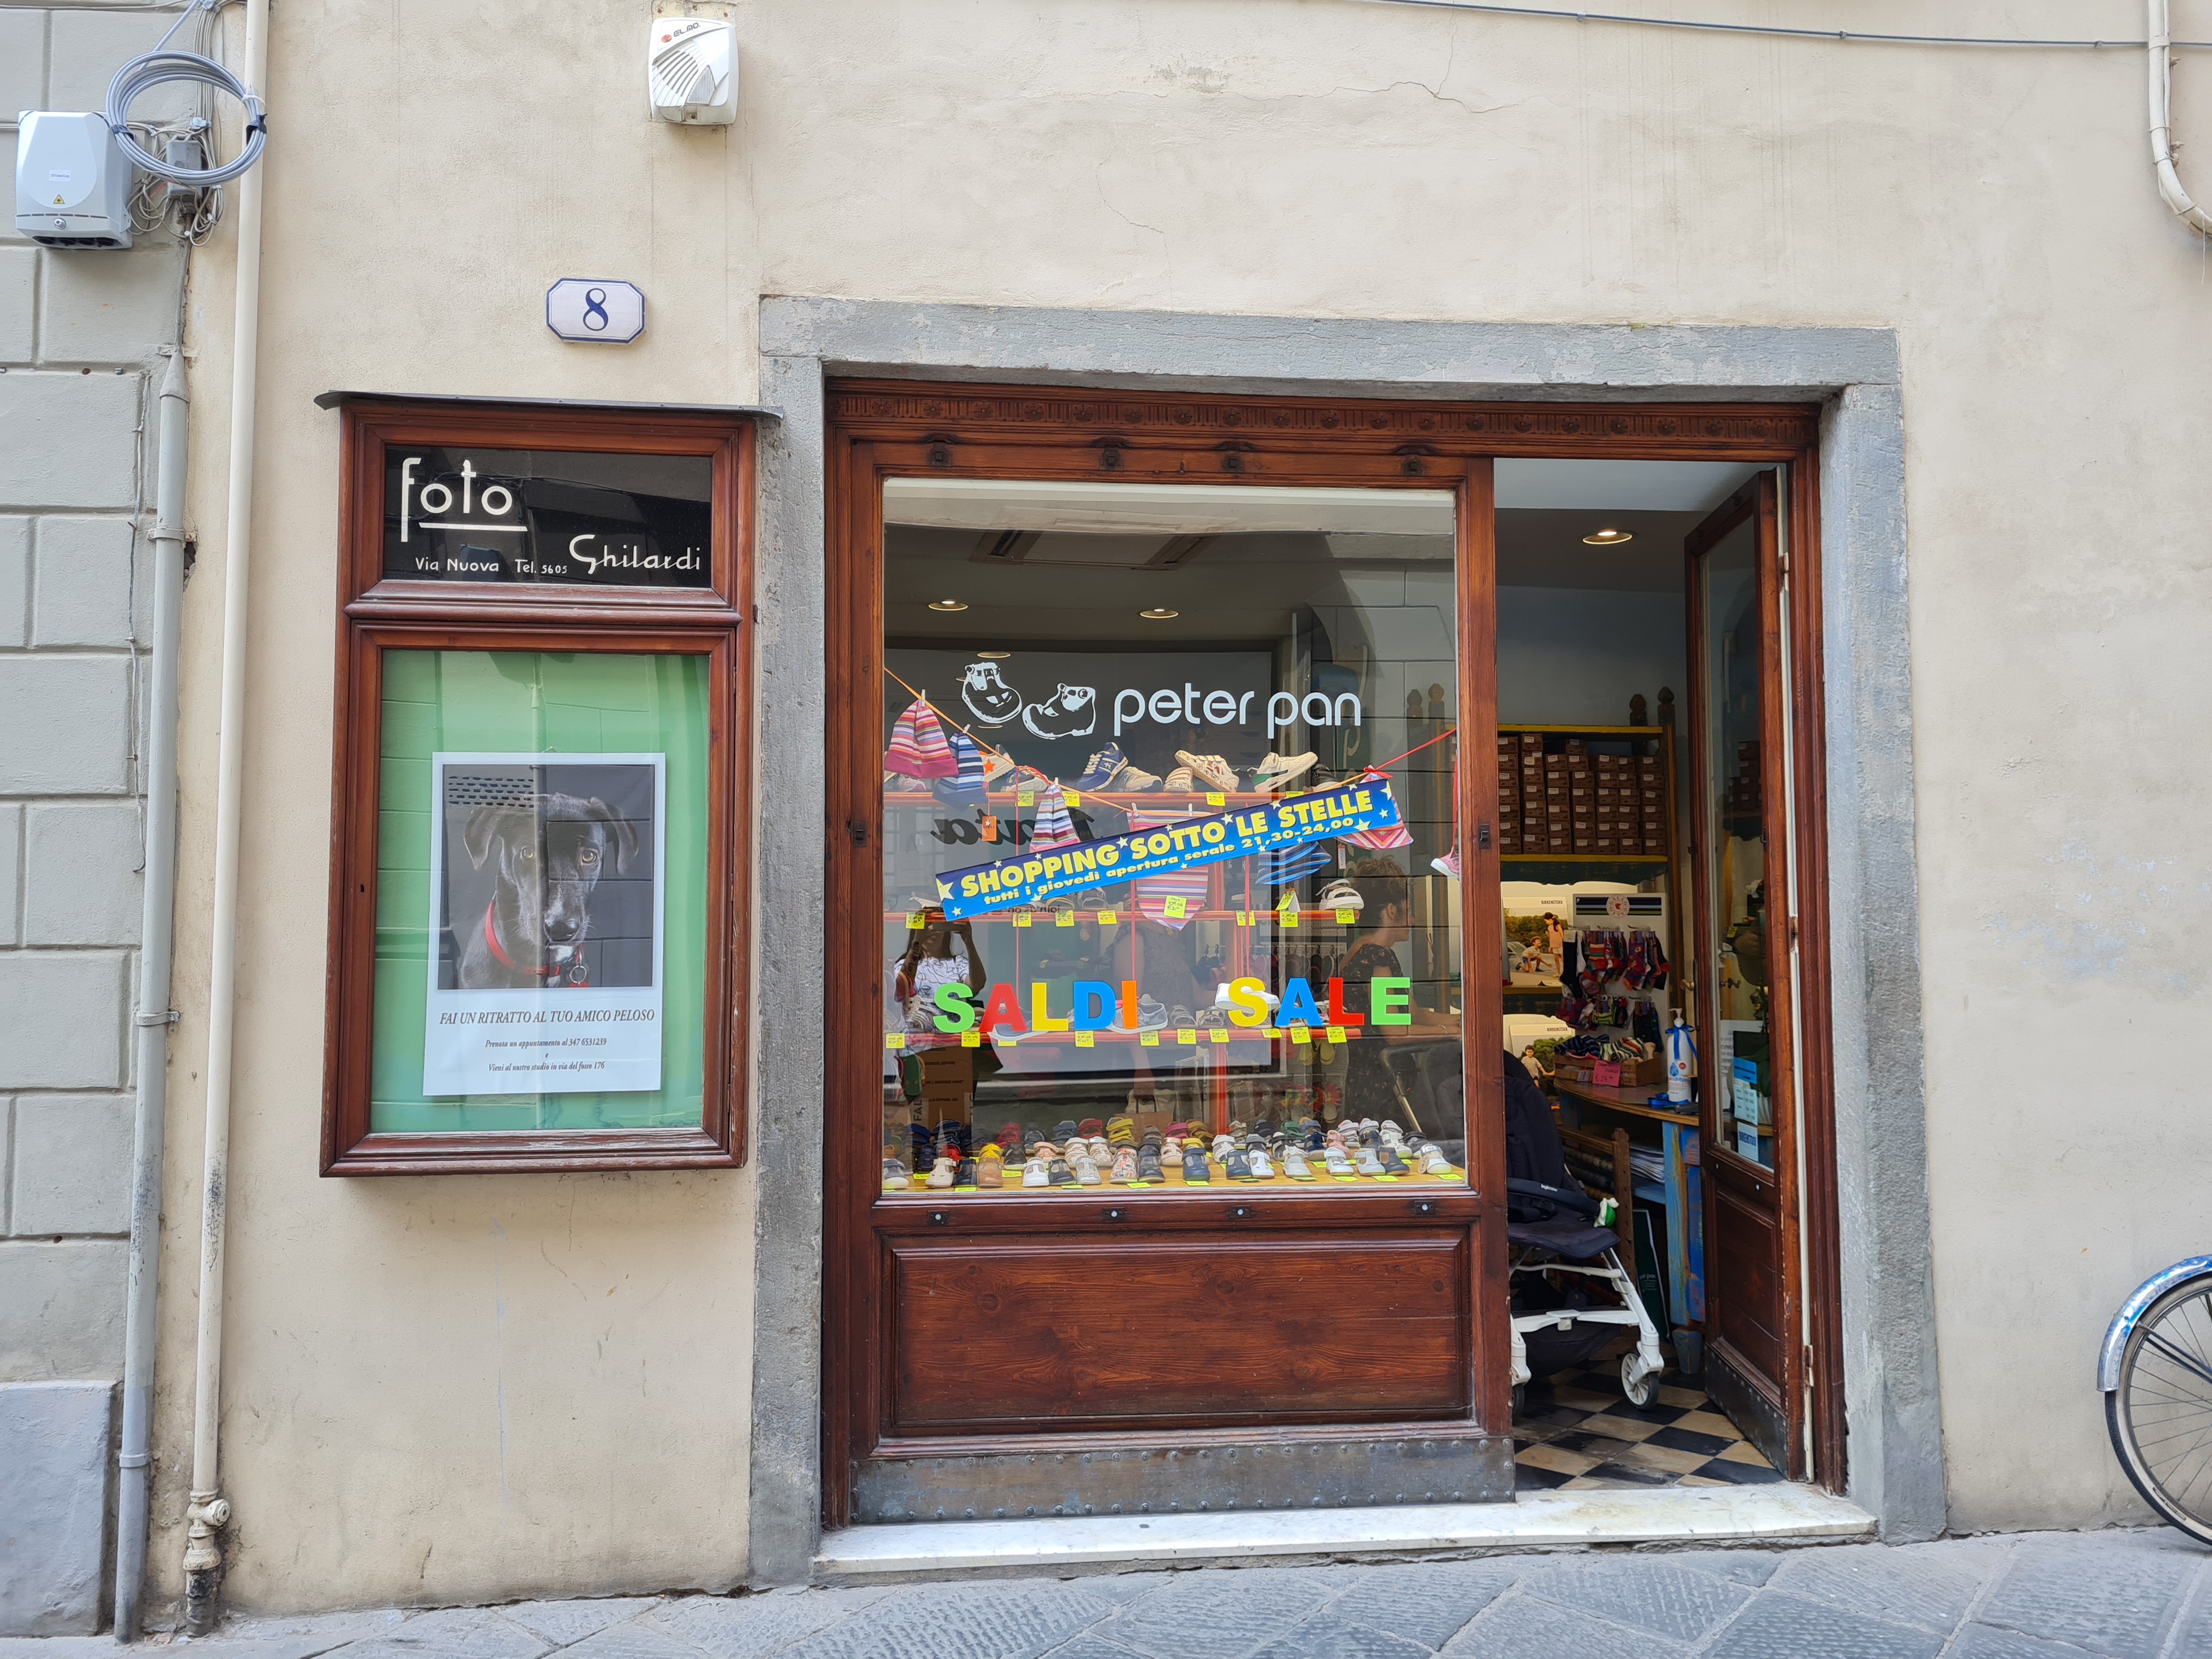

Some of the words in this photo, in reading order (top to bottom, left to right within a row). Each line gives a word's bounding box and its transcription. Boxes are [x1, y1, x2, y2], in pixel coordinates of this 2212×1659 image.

[583, 288, 608, 331] 8
[400, 457, 512, 543] foto
[415, 556, 439, 571] Via
[447, 558, 499, 573] Nuova
[515, 558, 537, 574] Tel.
[541, 564, 567, 574] 5605
[569, 534, 701, 574] Ghilardi
[1114, 682, 1255, 737] peter
[1267, 691, 1361, 739] pan
[961, 844, 1119, 897] SHOPPING
[1130, 821, 1226, 860] SOTTO
[1236, 811, 1268, 837] LE
[1278, 791, 1373, 828] STELLE
[984, 888, 1020, 905] tutti
[1025, 886, 1032, 896] i
[1037, 871, 1101, 895] giovedì
[1105, 857, 1179, 877] apertura
[1184, 843, 1235, 861] serale
[1241, 817, 1355, 849] 21,30-24,00
[439, 1012, 458, 1024] FAI
[460, 1012, 477, 1024] UN
[477, 1011, 531, 1024] RITRATTO
[532, 1011, 547, 1023] AL
[550, 1010, 573, 1023] TUO
[574, 1009, 611, 1022] AMICO
[613, 1009, 655, 1022] PELOSO
[932, 980, 1138, 1034] SALDI
[1227, 976, 1412, 1027] SALE
[518, 1040, 560, 1049] appuntamento
[561, 1037, 568, 1046] al
[568, 1038, 580, 1046] 347
[581, 1037, 607, 1046] 6531239
[505, 1063, 512, 1071] al
[531, 1062, 549, 1070] studio
[568, 1061, 577, 1069] del
[577, 1061, 592, 1072] fosso
[594, 1061, 605, 1069] 176
